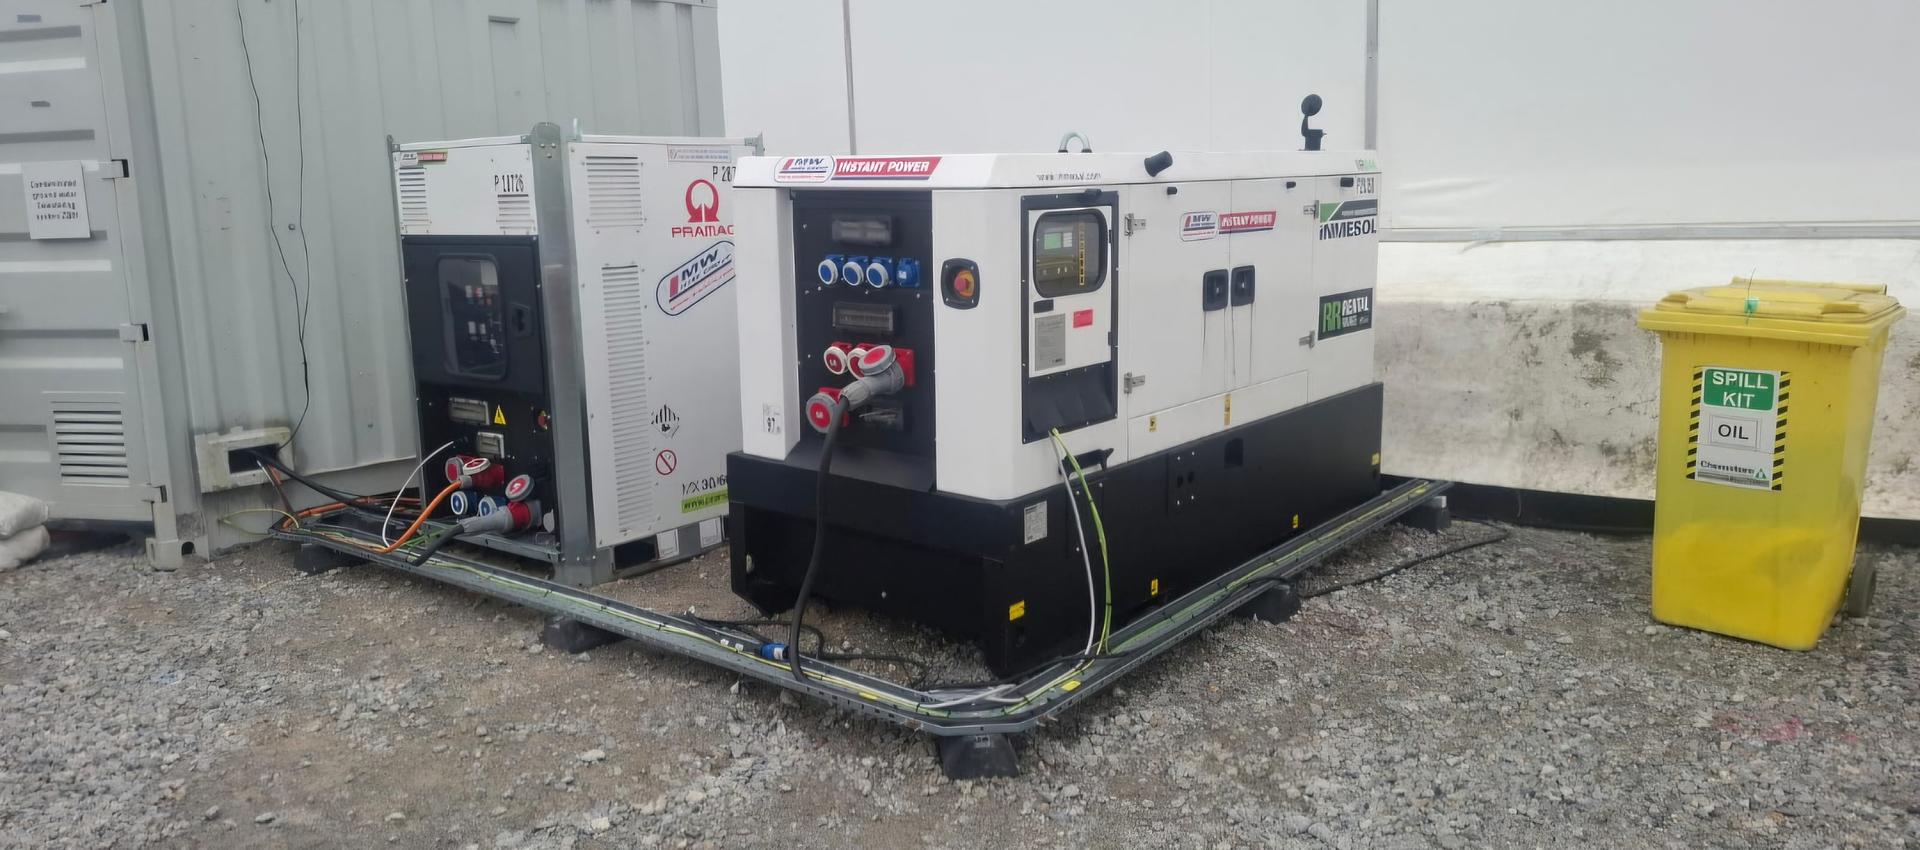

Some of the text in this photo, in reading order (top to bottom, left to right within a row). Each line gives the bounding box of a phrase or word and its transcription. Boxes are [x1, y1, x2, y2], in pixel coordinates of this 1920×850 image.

[839, 162, 884, 173] INSTANT
[887, 161, 929, 172] POWER
[671, 224, 735, 238] PRAMAC
[681, 248, 719, 281] MW
[1712, 371, 1769, 390] SPILL
[1722, 391, 1755, 409] KIT
[1717, 424, 1749, 440] OIL
